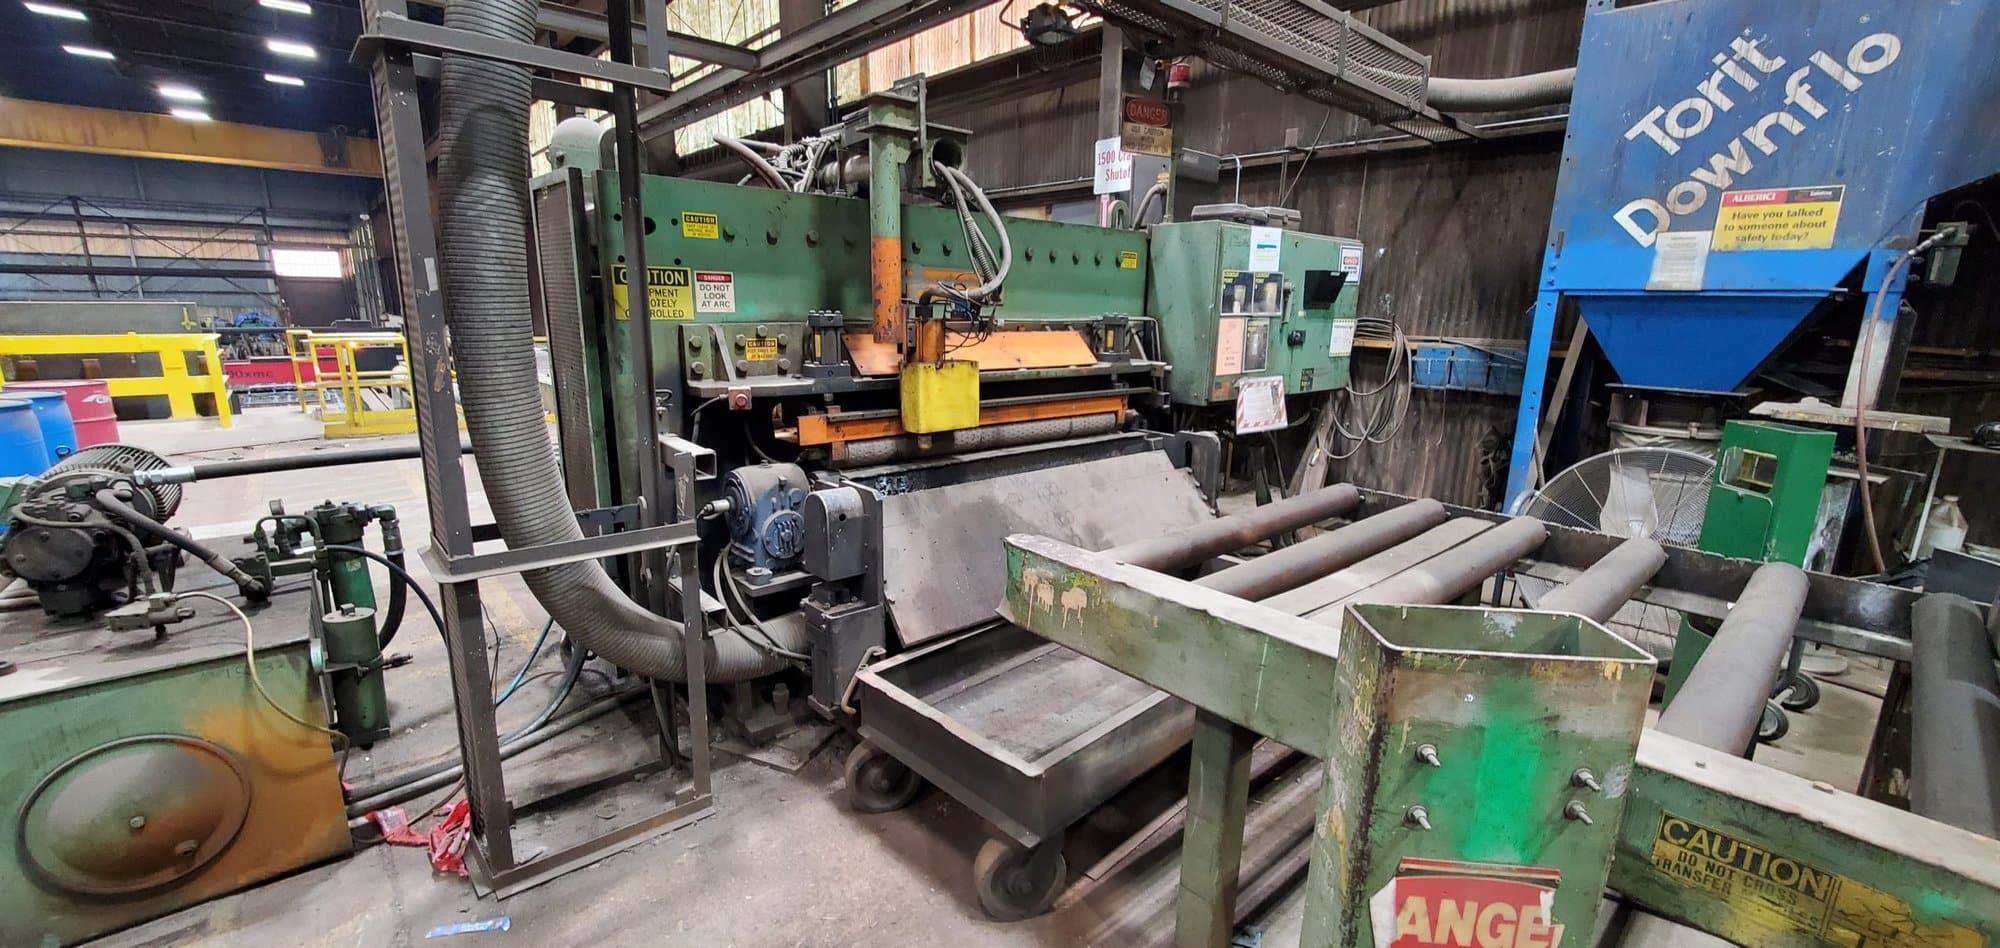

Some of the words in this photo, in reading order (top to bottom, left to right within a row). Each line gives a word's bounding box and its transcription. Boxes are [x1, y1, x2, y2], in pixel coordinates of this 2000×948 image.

[1624, 36, 1787, 156] Torit
[1129, 103, 1168, 121] DANGER
[1613, 33, 1901, 249] Downflo
[1097, 151, 1116, 165] 1500
[1119, 150, 1132, 162] Cra
[1105, 165, 1131, 181] Shutof
[1732, 191, 1777, 202] ALBERICI
[685, 215, 715, 223] CAUTION
[1732, 211, 1759, 220] Have
[1762, 211, 1784, 221] you
[1786, 207, 1824, 217] talked
[1738, 222, 1789, 230] someone
[1792, 220, 1827, 229] about
[1735, 233, 1768, 243] safety
[1771, 231, 1809, 242] today?
[619, 270, 685, 285] CTION
[699, 284, 712, 292] DO
[714, 284, 730, 292] NOT
[704, 292, 727, 300] LOOK
[701, 300, 712, 308] AT
[713, 300, 731, 308] ARC
[625, 309, 684, 319] CROLLED
[1663, 818, 1831, 900] CAUTION
[1655, 857, 1733, 897] TRANSFER
[1677, 850, 1698, 867] DO
[1705, 859, 1737, 881] NOT
[1743, 875, 1798, 906] CROSS
[1396, 896, 1564, 948] ANGE
